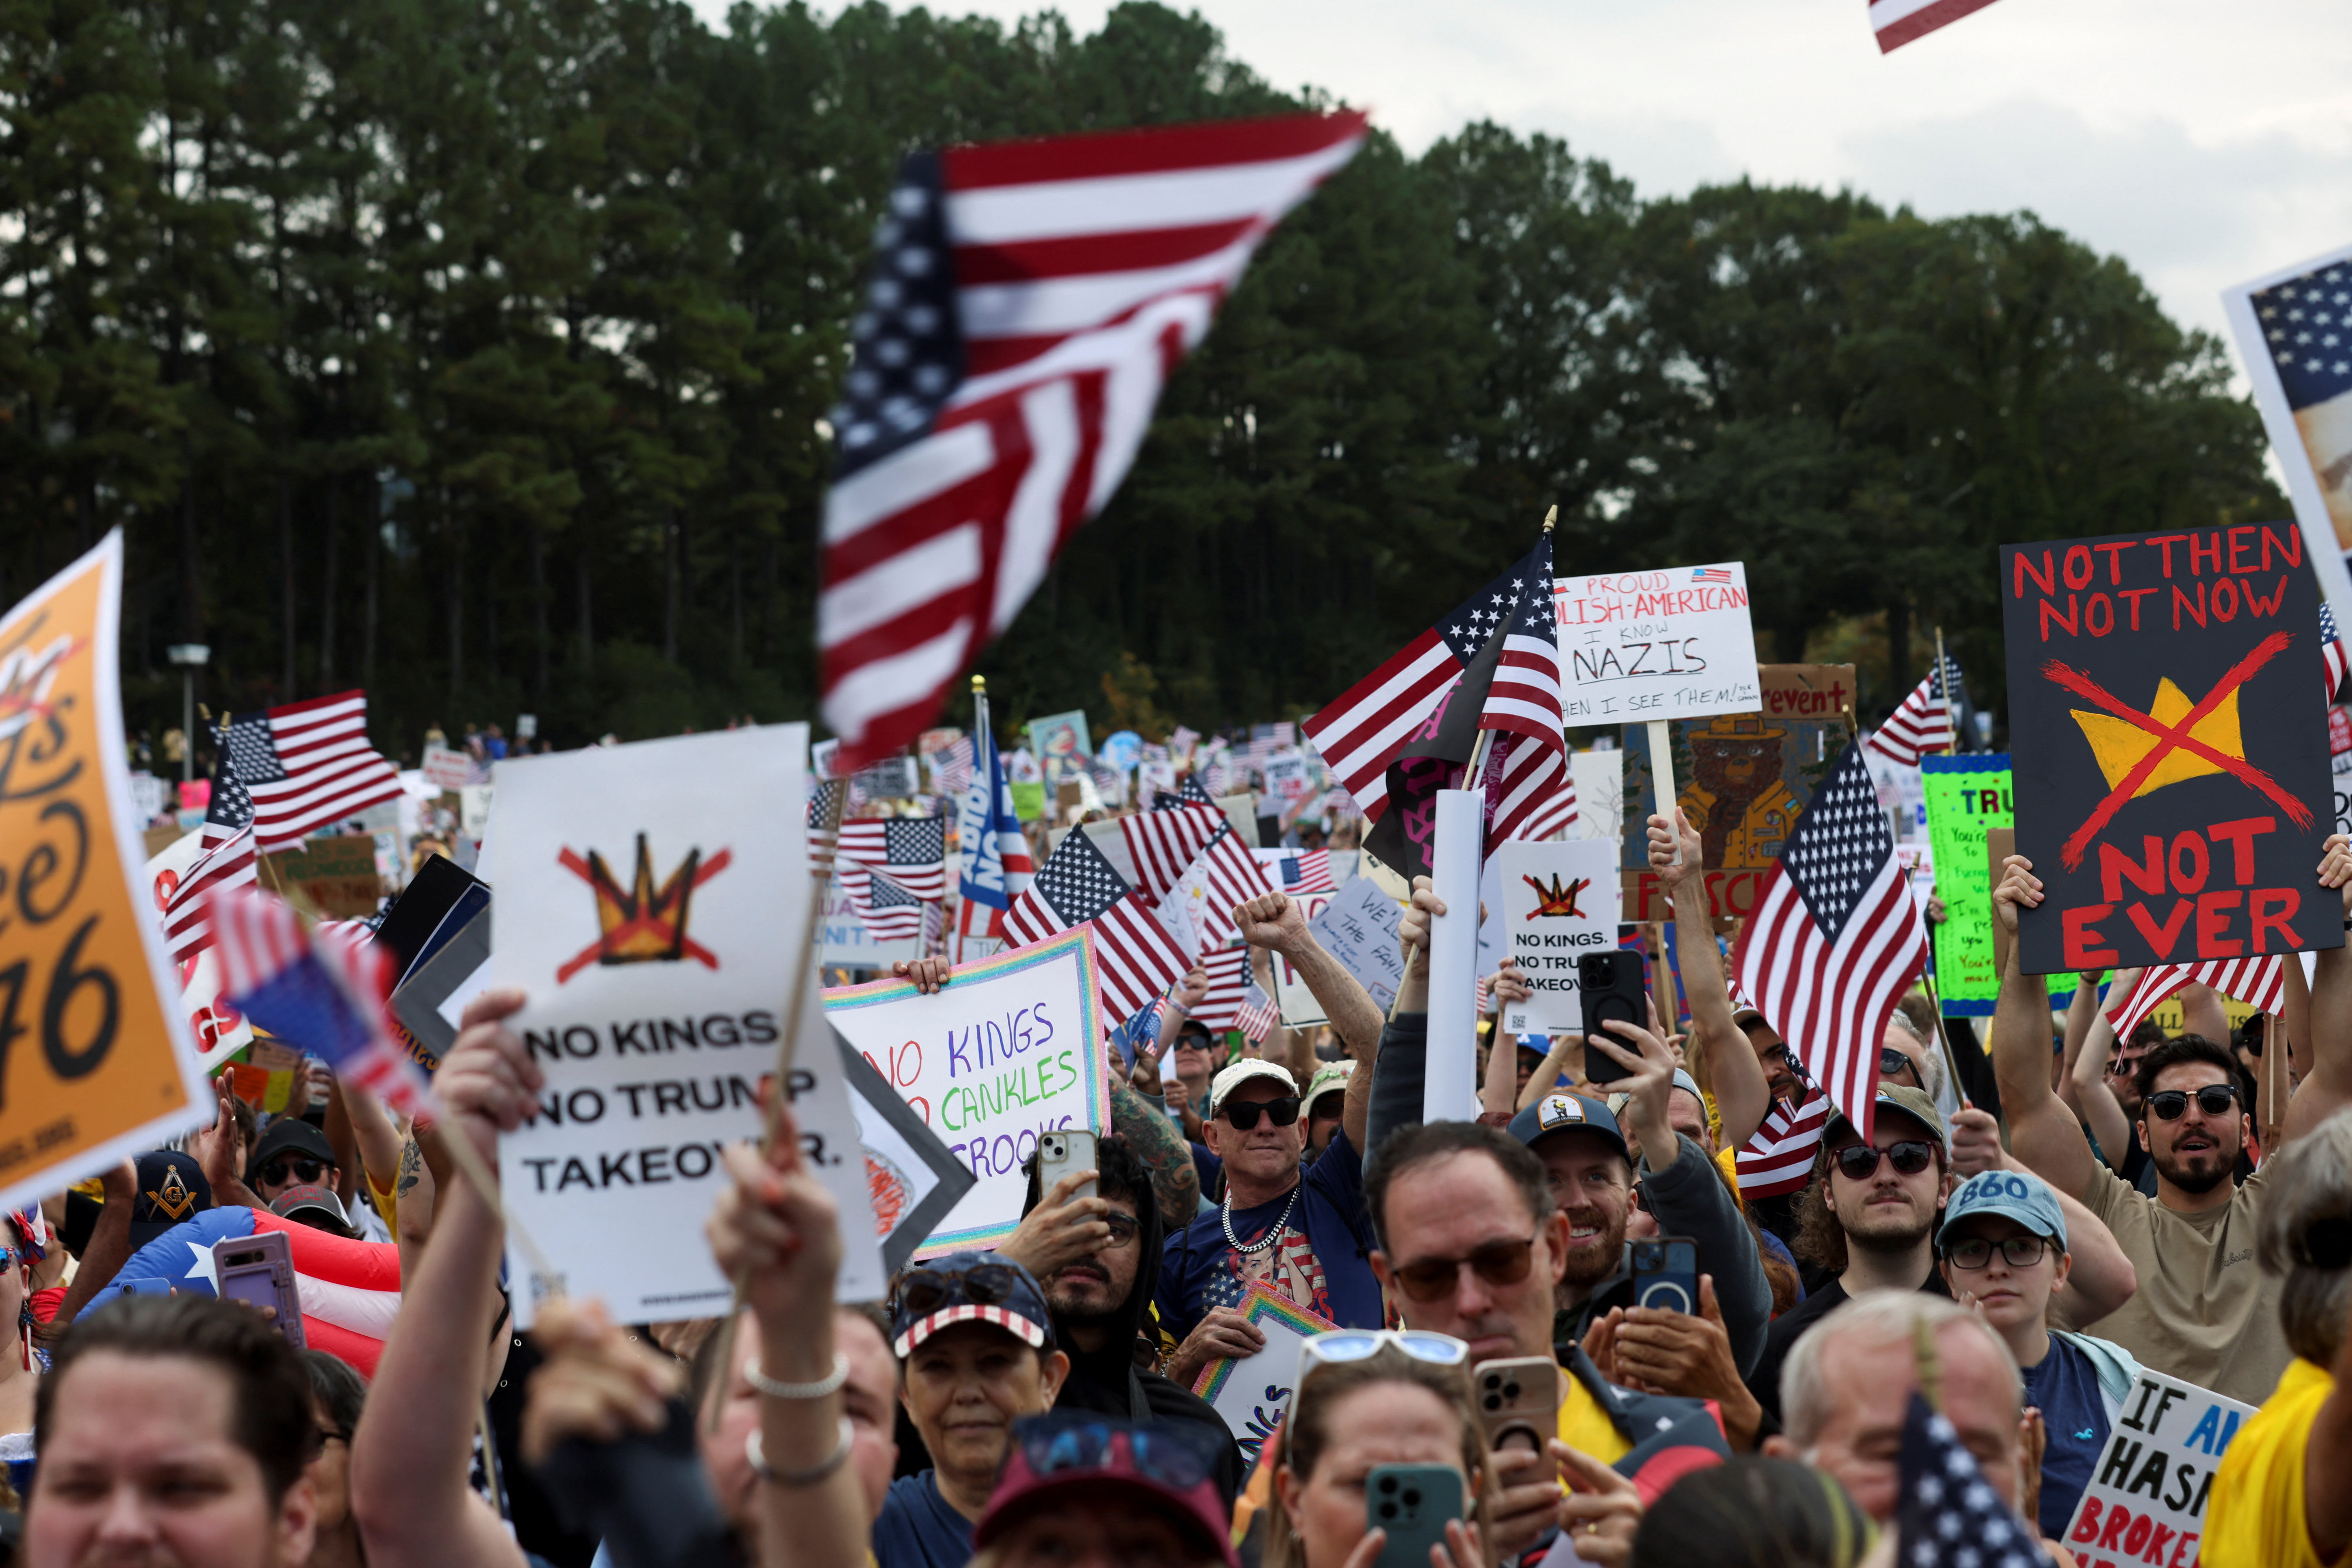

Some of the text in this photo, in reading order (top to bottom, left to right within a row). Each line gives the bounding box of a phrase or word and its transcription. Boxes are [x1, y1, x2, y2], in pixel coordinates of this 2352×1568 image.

[2014, 524, 2301, 599] NOT THEN
[1587, 572, 1670, 595] PROUD
[1554, 586, 1748, 625] LISH-AMERICAN
[2039, 575, 2288, 642] NOT NOW
[1584, 621, 1669, 645] I KNOW
[1574, 637, 1706, 681] NAZIS
[1562, 683, 1737, 718] HEN I SEE THEM!
[1760, 680, 1847, 715] revent
[1960, 789, 2014, 814] TRU
[2098, 816, 2276, 902] NOT
[1340, 913, 1365, 944] THE
[1516, 932, 1608, 947] NO KINGS.
[2061, 887, 2304, 969] EVER
[1370, 944, 1403, 985] FAMIL
[1515, 955, 1579, 969] NO TRU
[1958, 954, 1996, 969] You'r
[1524, 978, 1581, 991] AKEOV
[525, 1025, 600, 1063] NO
[948, 1002, 1054, 1077] KINGS
[525, 1089, 607, 1129] NO
[942, 1050, 1077, 1131] CANKLES
[522, 1131, 842, 1193] TAKEOR.
[1959, 1174, 2028, 1206] 860
[2120, 1378, 2187, 1435] IF
[2070, 1495, 2200, 1568] BROKE
